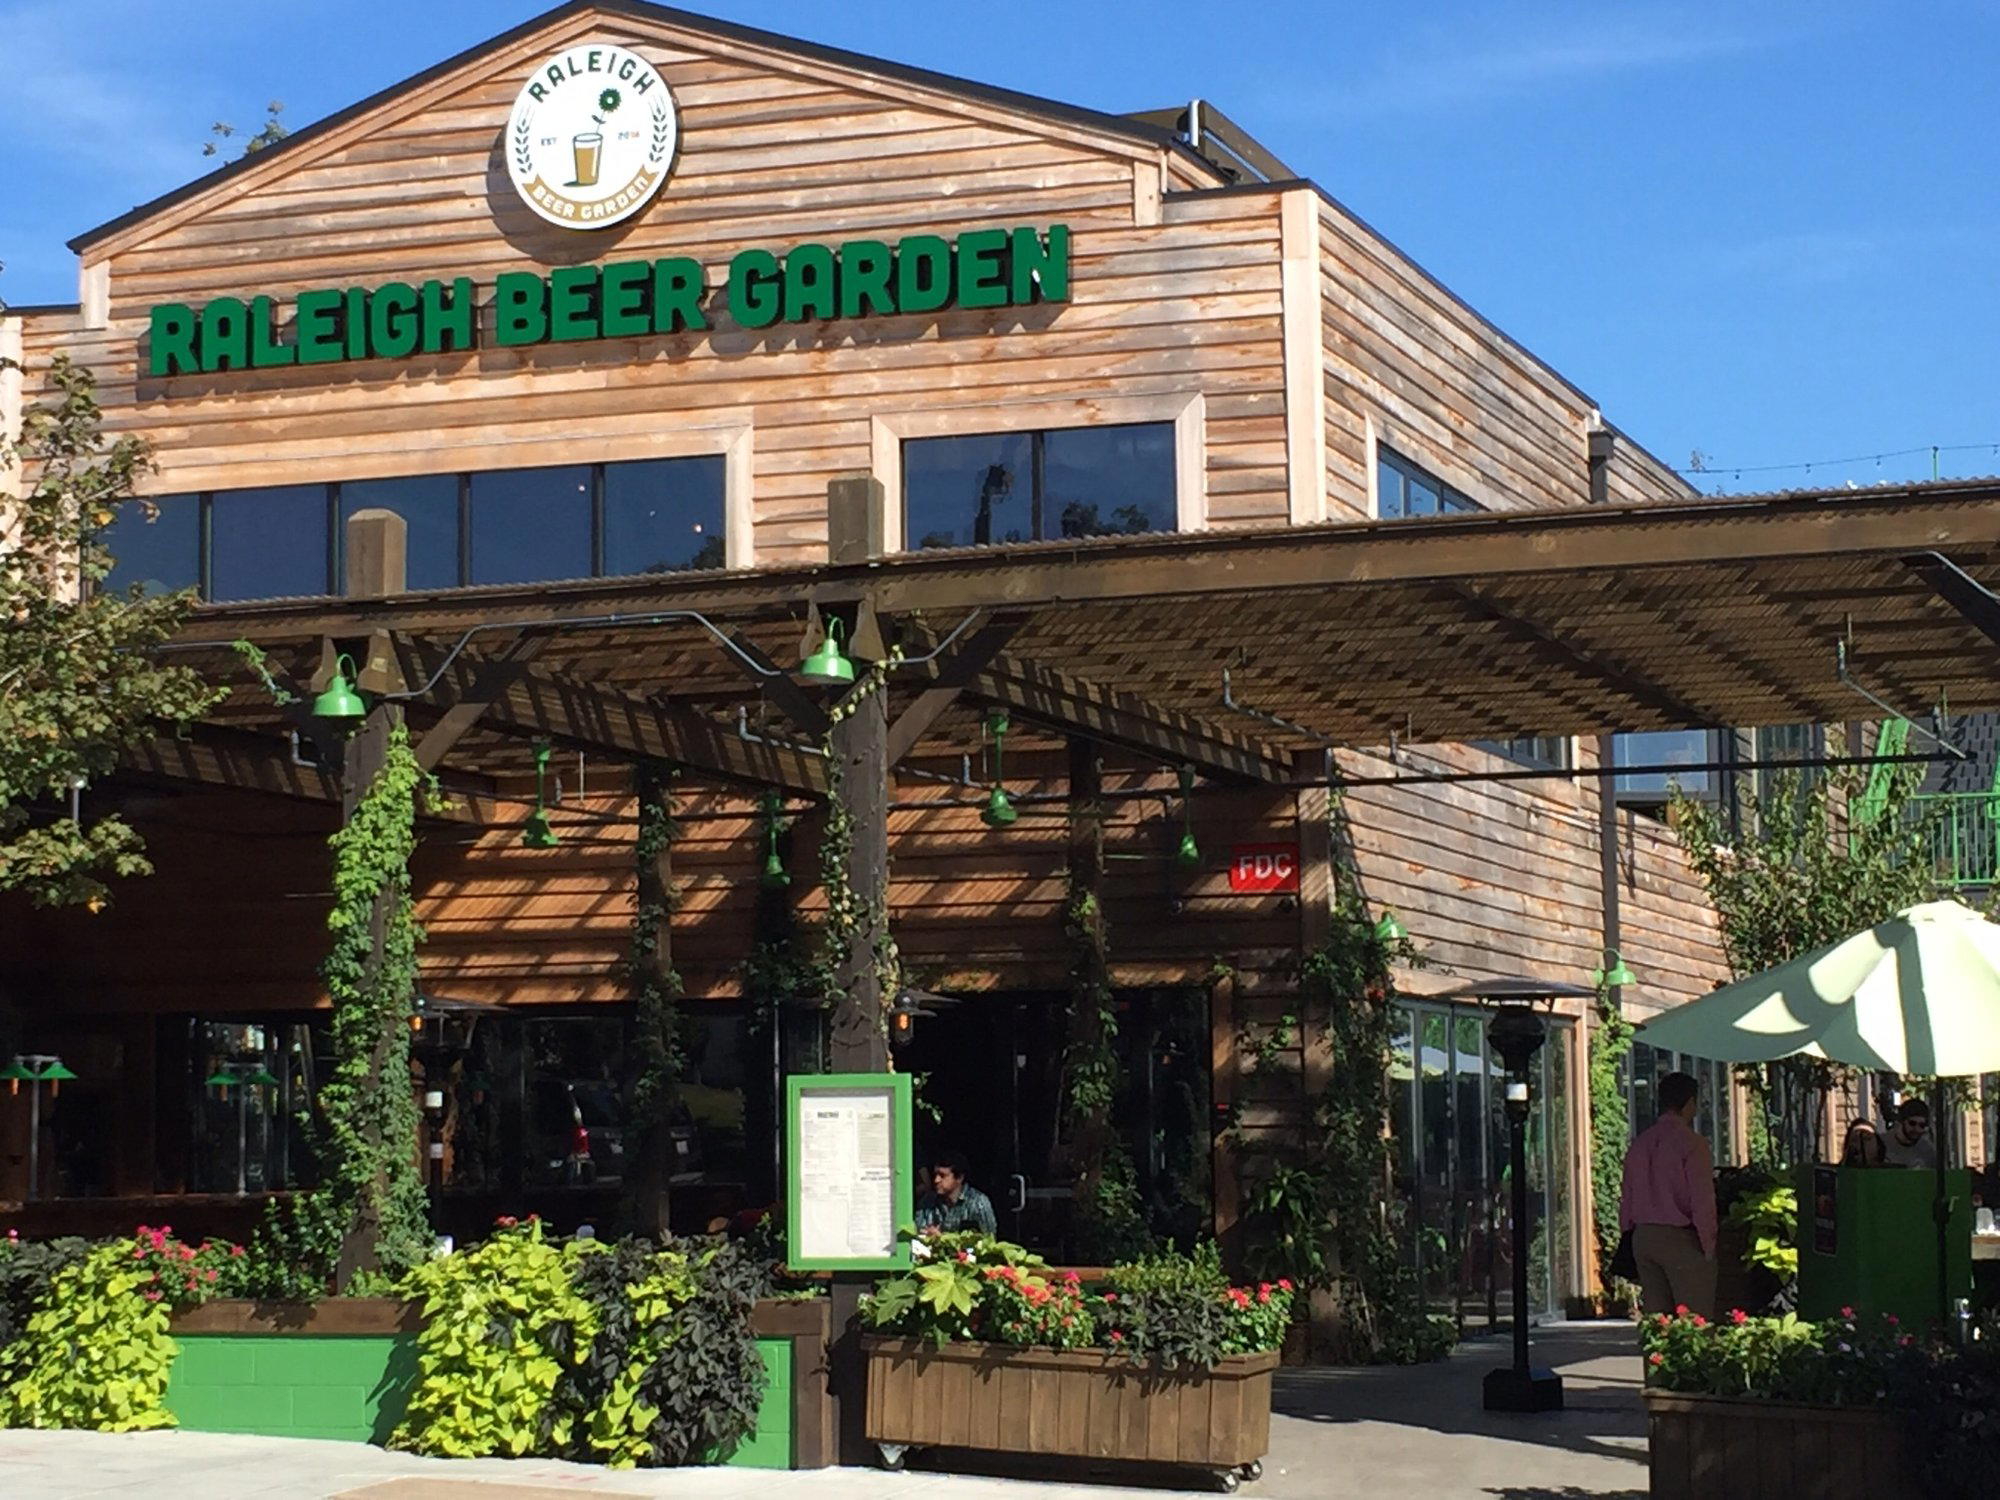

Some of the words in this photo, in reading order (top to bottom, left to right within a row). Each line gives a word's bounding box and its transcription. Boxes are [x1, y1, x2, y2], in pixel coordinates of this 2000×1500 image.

[528, 51, 655, 103] RALEIGH
[532, 184, 576, 219] BEER
[580, 176, 649, 219] GARDEN
[150, 277, 473, 376] RALEIGH
[496, 250, 708, 345] BEER
[728, 224, 1069, 328] GARDEN
[1239, 853, 1292, 880] FDC
